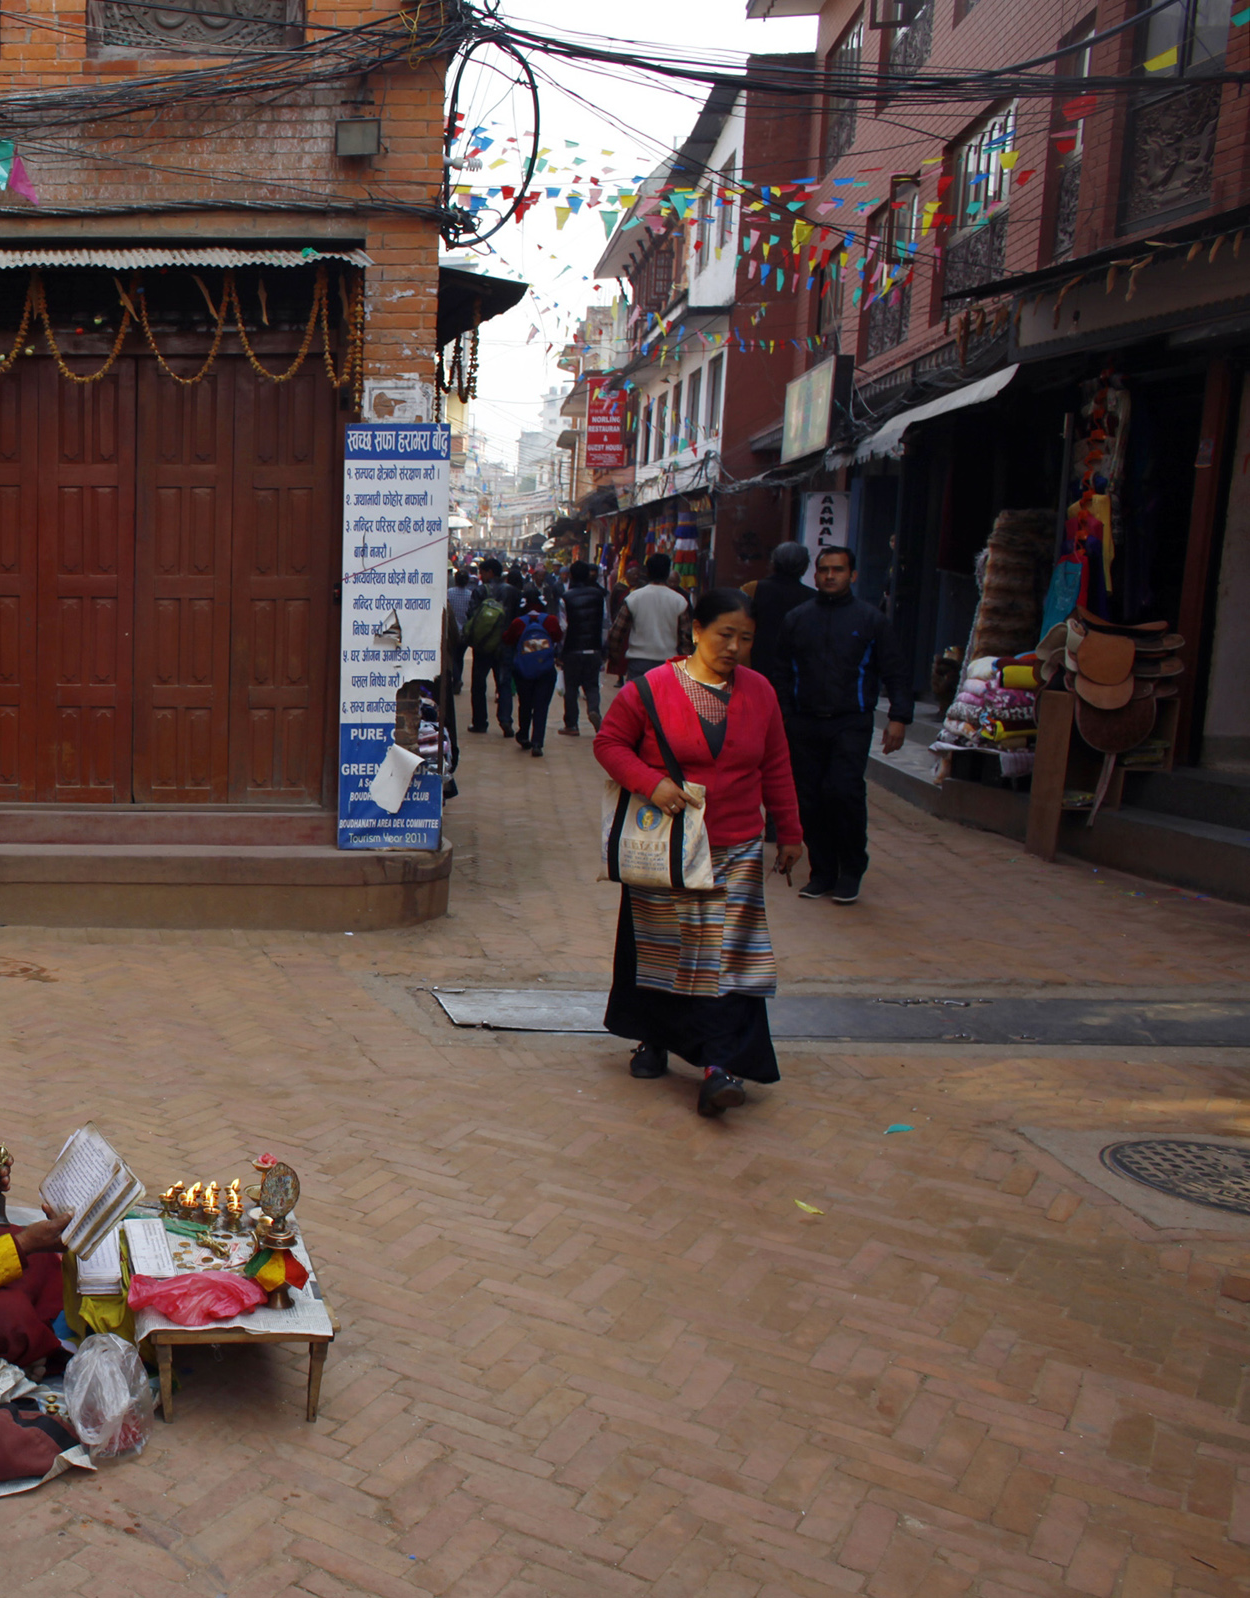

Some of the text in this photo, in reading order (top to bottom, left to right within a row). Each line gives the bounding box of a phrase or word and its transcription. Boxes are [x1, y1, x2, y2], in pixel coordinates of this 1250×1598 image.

[347, 431, 372, 452] स्वच्छ
[374, 431, 396, 452] सफा
[398, 431, 430, 452] हराभरा
[350, 728, 387, 742] PURE,
[412, 792, 430, 801] CLUB
[339, 819, 376, 828] BOUDHANATH
[377, 819, 392, 828] AREA
[406, 819, 439, 828] COMMITTEE
[349, 833, 427, 843] Tourism Year 2011
